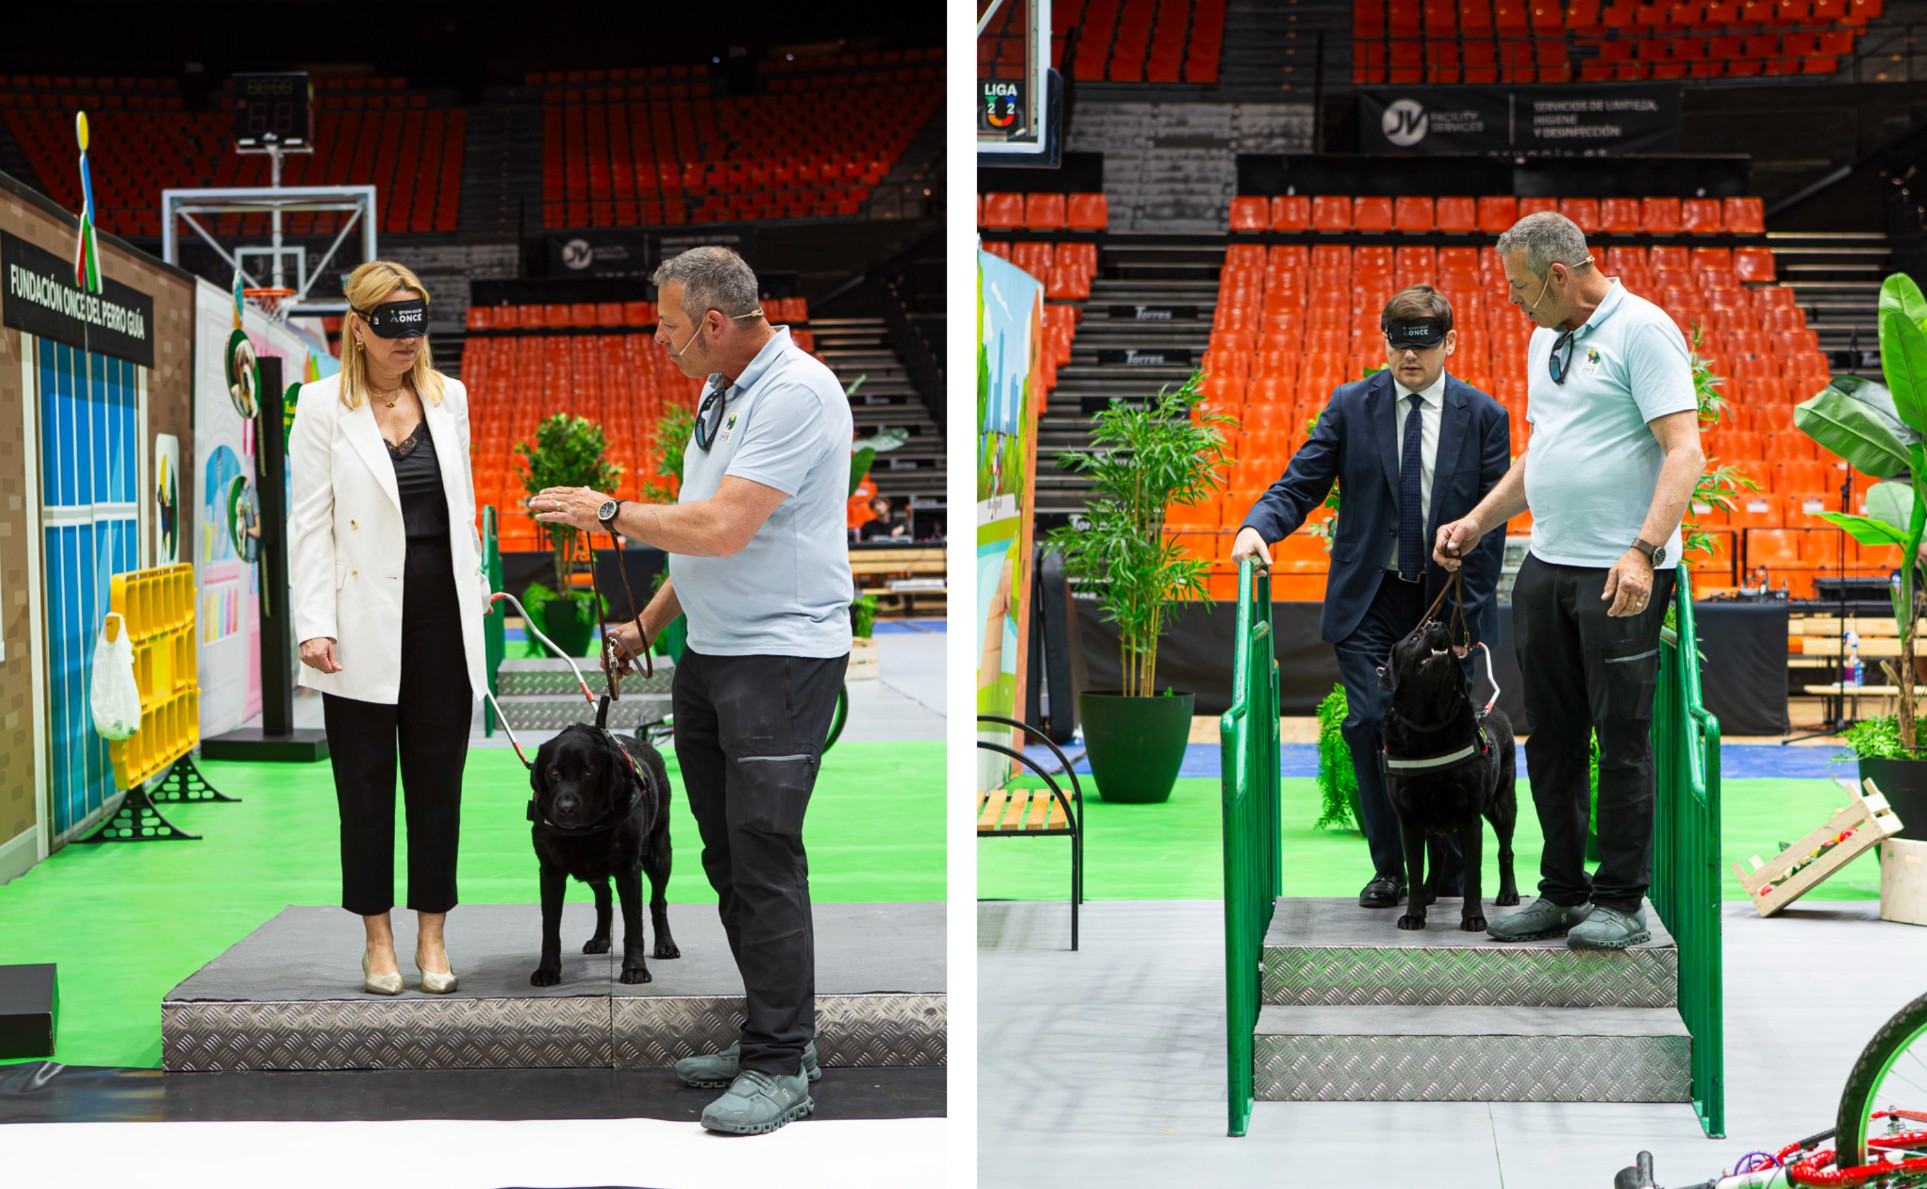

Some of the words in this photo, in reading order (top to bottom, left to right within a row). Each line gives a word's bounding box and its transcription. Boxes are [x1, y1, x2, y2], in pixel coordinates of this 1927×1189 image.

[985, 83, 1018, 97] LIGA
[10, 263, 63, 313] FUNDACIÓN
[63, 286, 86, 321] ONCE
[86, 295, 102, 326] DEL
[102, 300, 126, 334] PERRO
[127, 308, 145, 340] GUÍA
[399, 314, 422, 323] ONCE
[1135, 306, 1172, 320] Torres
[1125, 350, 1165, 364] Torres
